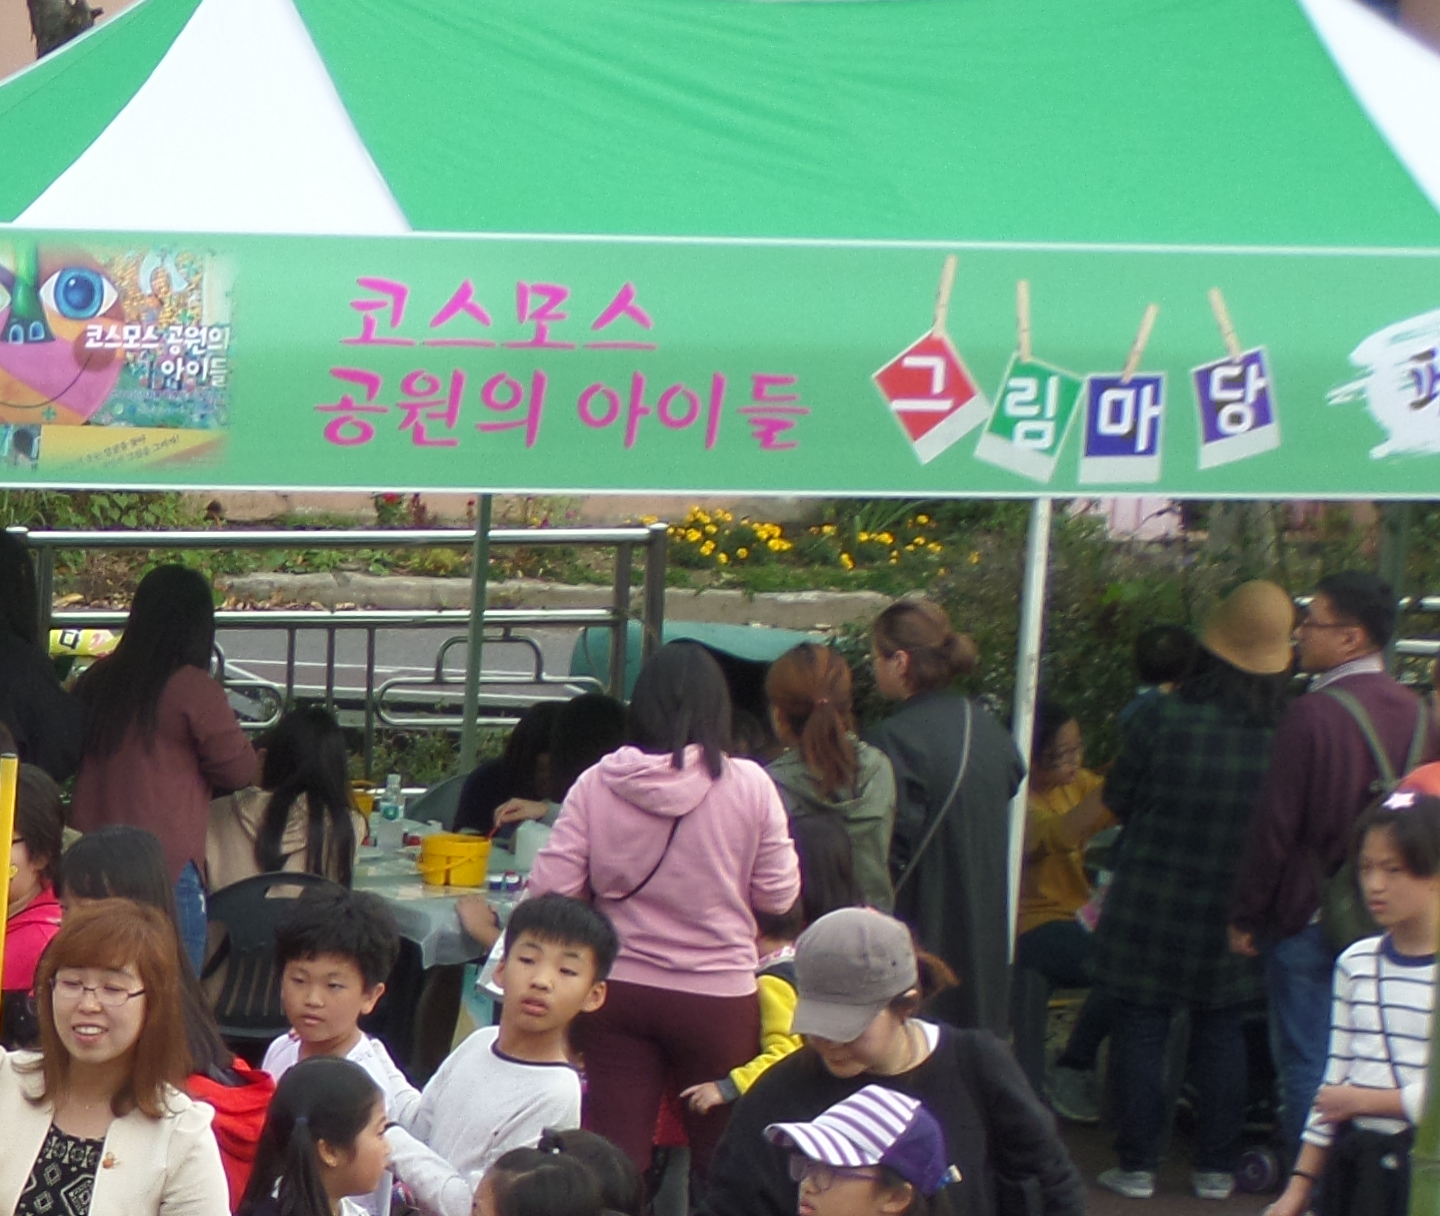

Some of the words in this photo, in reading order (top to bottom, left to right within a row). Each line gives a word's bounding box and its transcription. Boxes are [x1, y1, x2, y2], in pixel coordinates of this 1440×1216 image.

[338, 276, 658, 350] 코스모스
[84, 324, 160, 349] 코스모스
[167, 325, 230, 355] 공원의
[161, 357, 228, 387] 아이들
[313, 367, 548, 449] 공원의
[576, 369, 811, 450] 아이들
